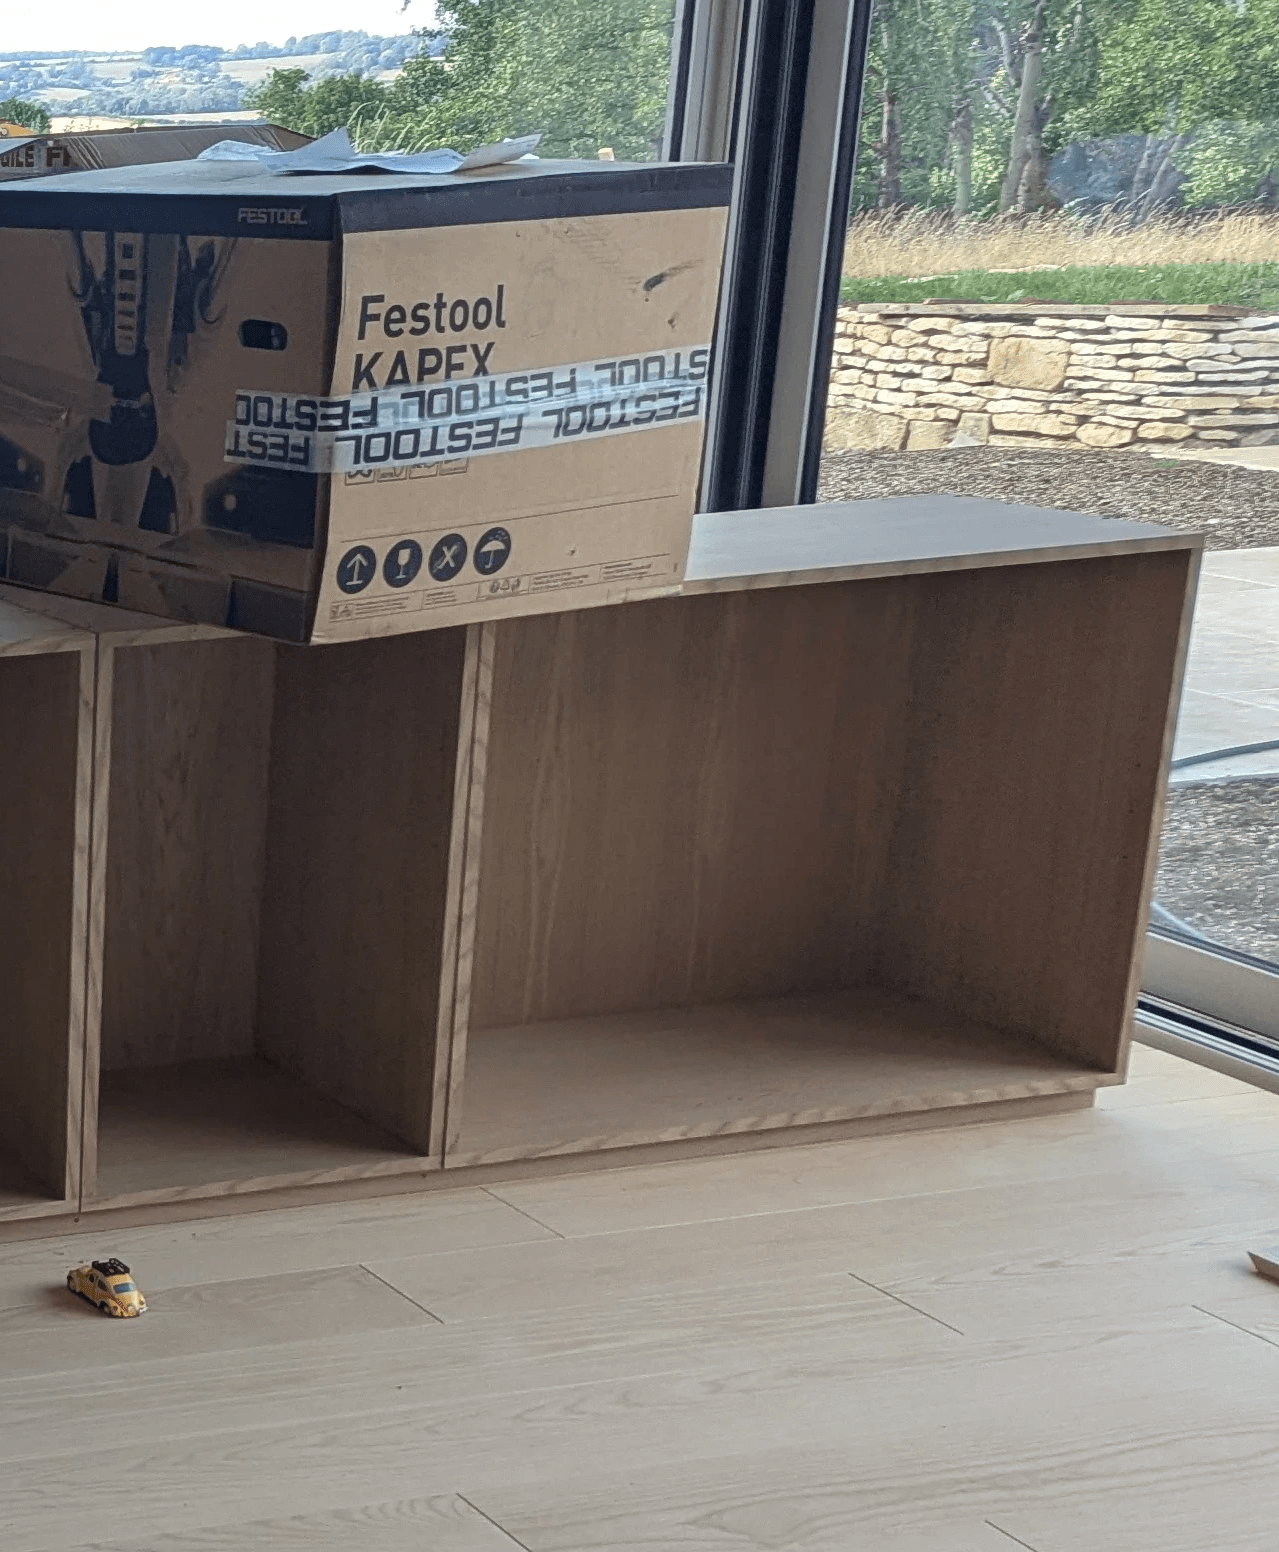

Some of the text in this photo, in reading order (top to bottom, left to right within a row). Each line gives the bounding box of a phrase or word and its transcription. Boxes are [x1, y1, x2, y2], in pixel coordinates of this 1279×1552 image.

[238, 207, 308, 225] FESTOOL
[357, 284, 506, 341] Festool
[400, 367, 577, 418] FESTOOL
[226, 386, 702, 465] FESTOOL FESTOOL FEST
